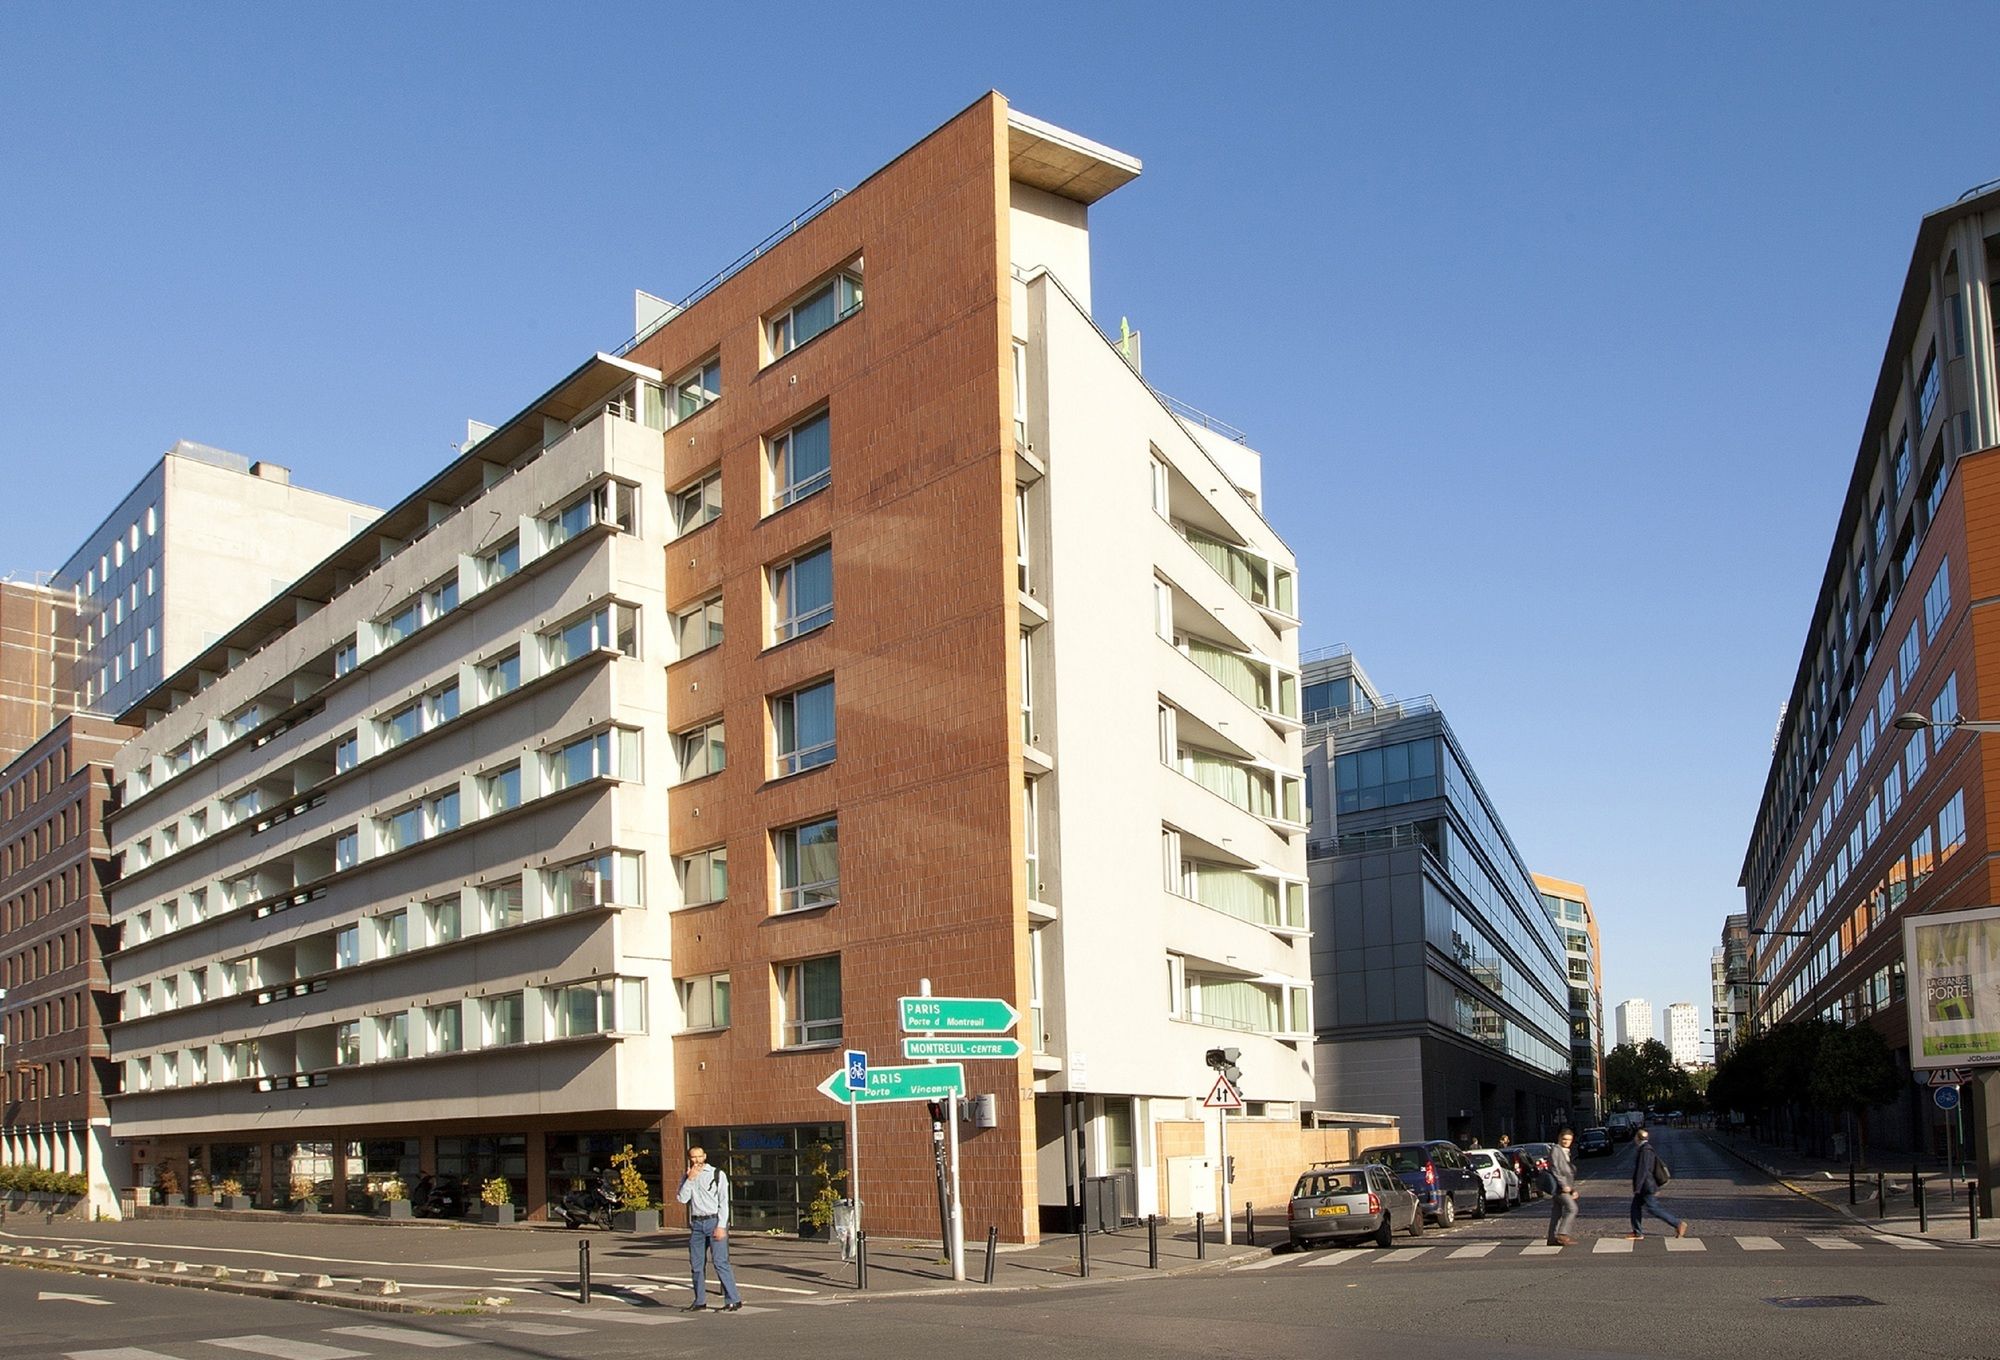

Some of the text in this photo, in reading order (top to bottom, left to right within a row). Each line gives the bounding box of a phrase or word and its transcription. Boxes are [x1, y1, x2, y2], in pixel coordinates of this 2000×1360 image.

[1927, 976, 1967, 988] LA GRANDE
[1928, 985, 1968, 1000] PORTE
[907, 1004, 940, 1014] PARIS
[908, 1017, 931, 1026] Porte
[946, 1018, 985, 1026] Montreuil
[910, 1043, 1002, 1054] MONTREUIL-CENTRE
[872, 1073, 902, 1085] ARIS
[864, 1087, 891, 1097] Porte
